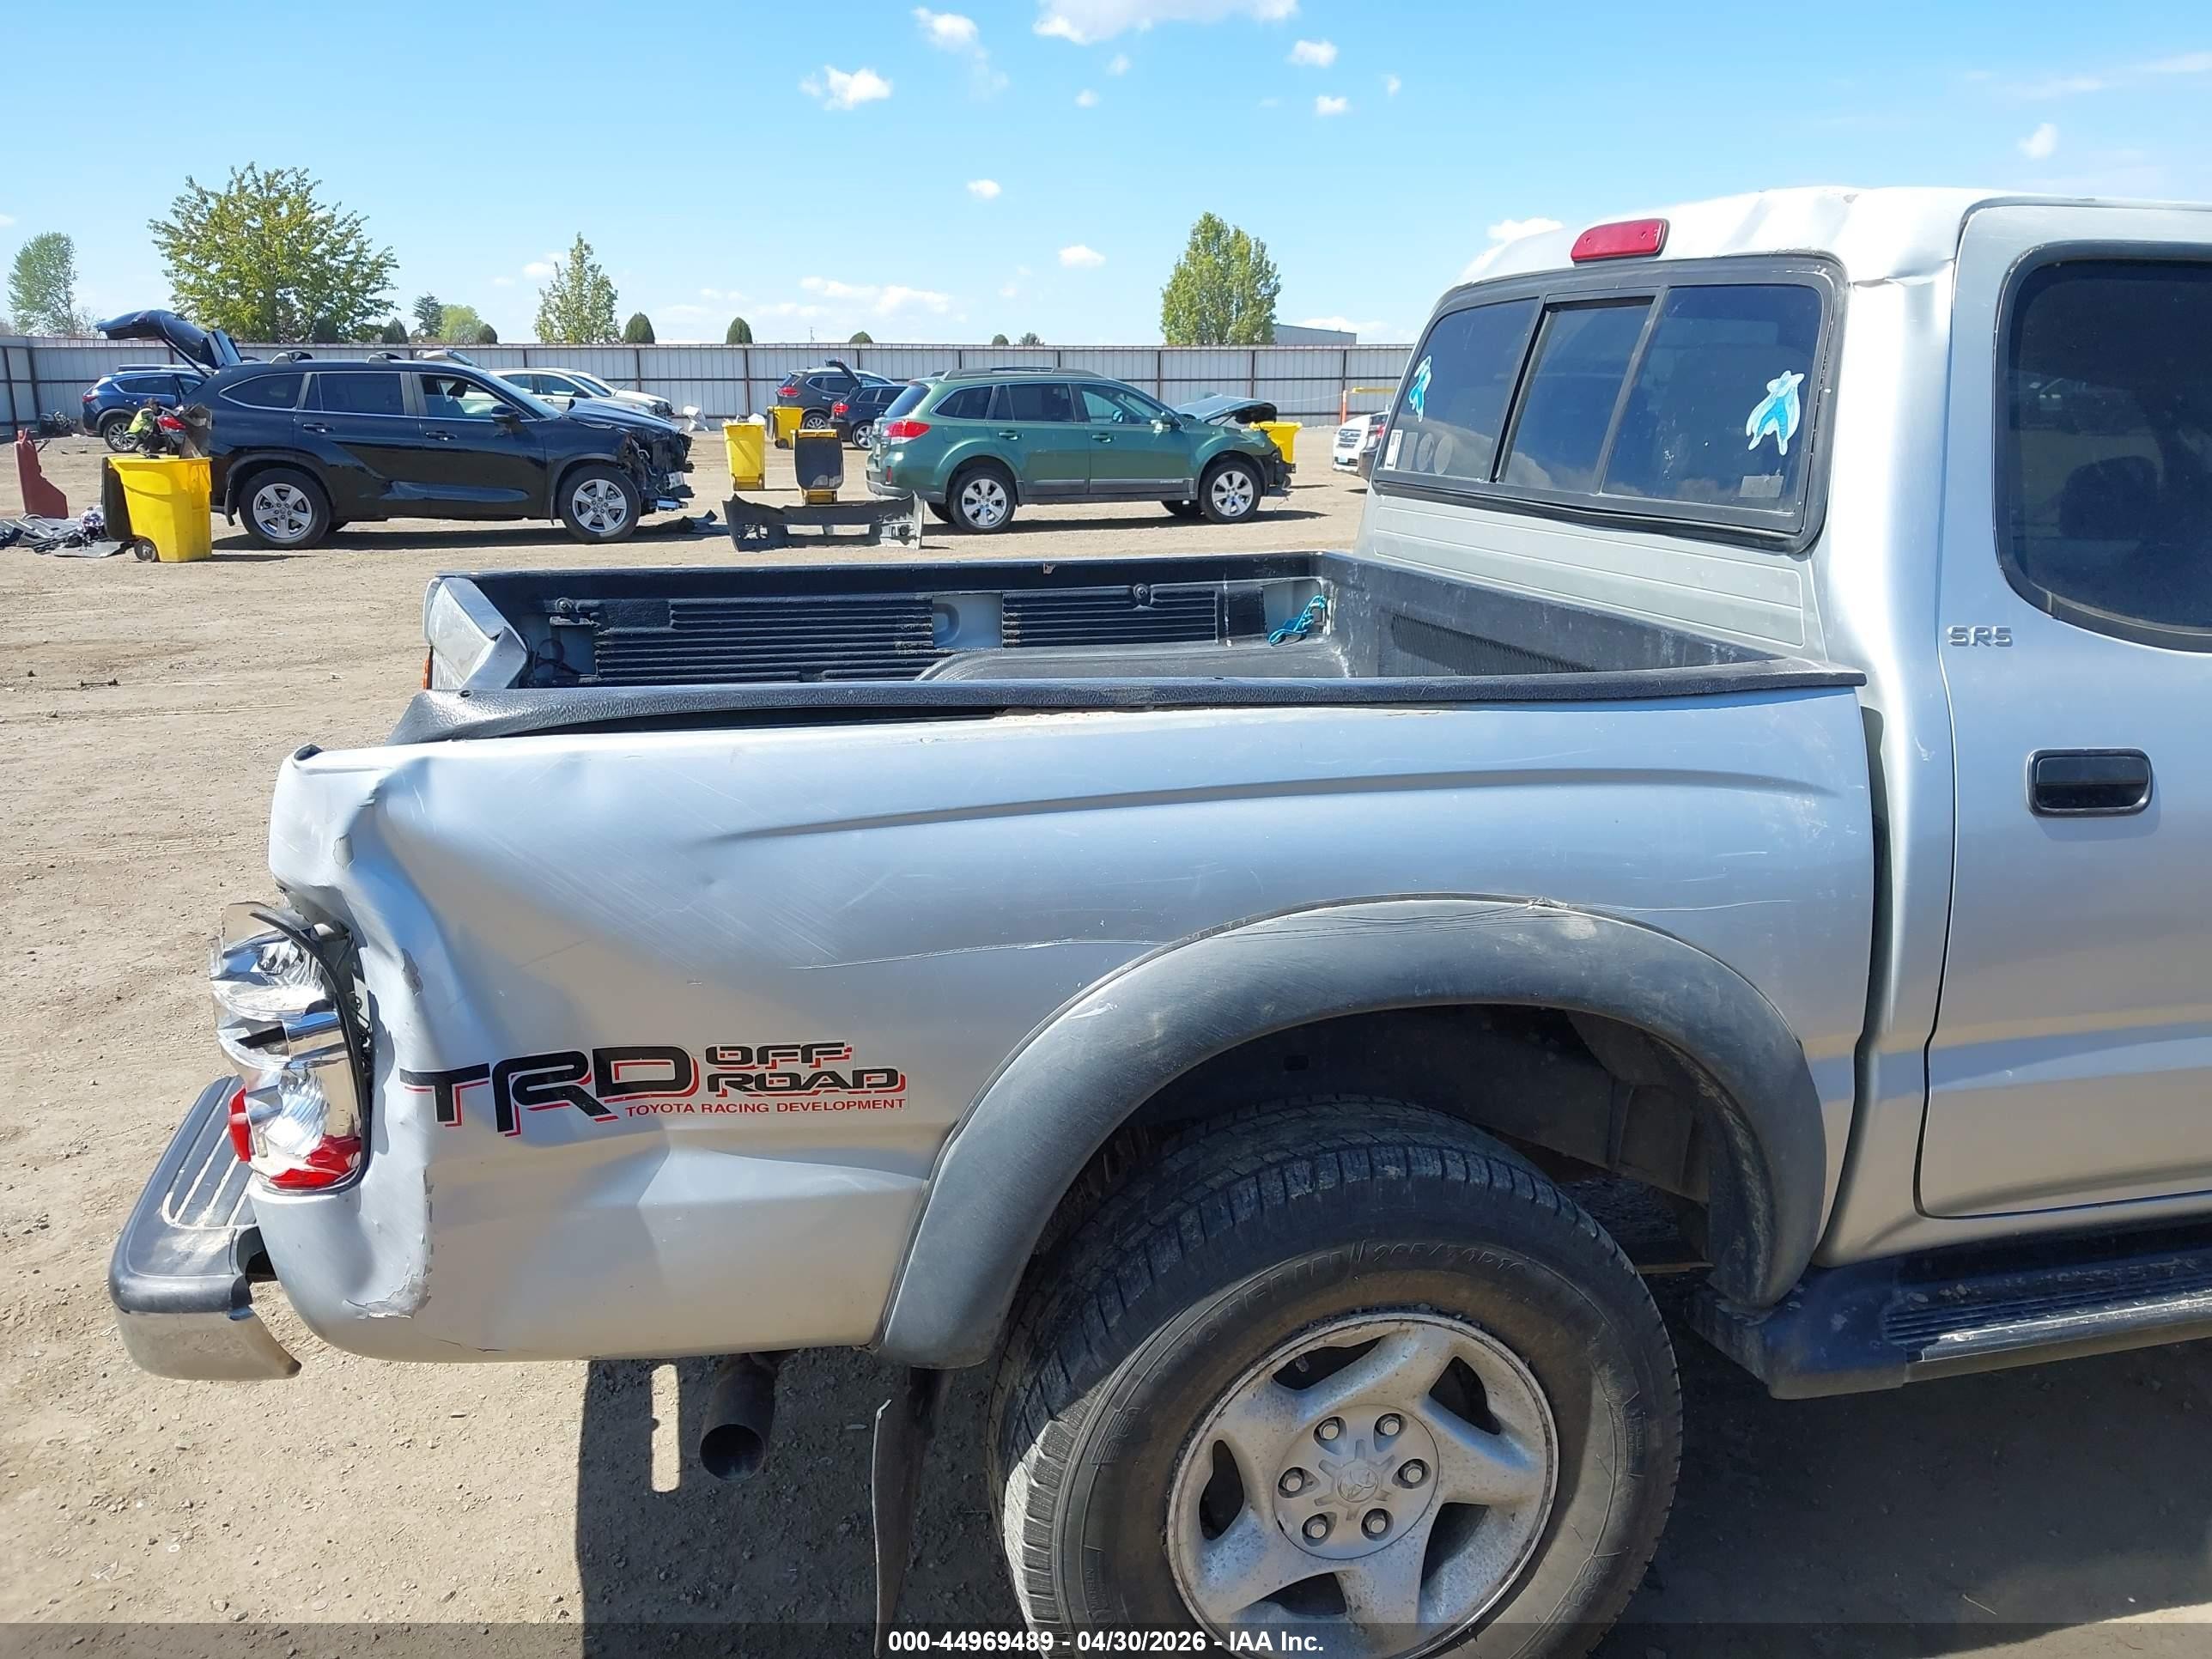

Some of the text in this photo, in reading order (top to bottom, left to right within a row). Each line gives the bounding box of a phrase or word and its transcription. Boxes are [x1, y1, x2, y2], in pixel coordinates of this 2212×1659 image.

[1947, 625, 2014, 647] SR5
[704, 1040, 853, 1070] OFF
[399, 1044, 699, 1137] TRD
[707, 1068, 907, 1098] ROAD
[624, 1097, 906, 1117] TOYOTA RACING DEVELOPMENT
